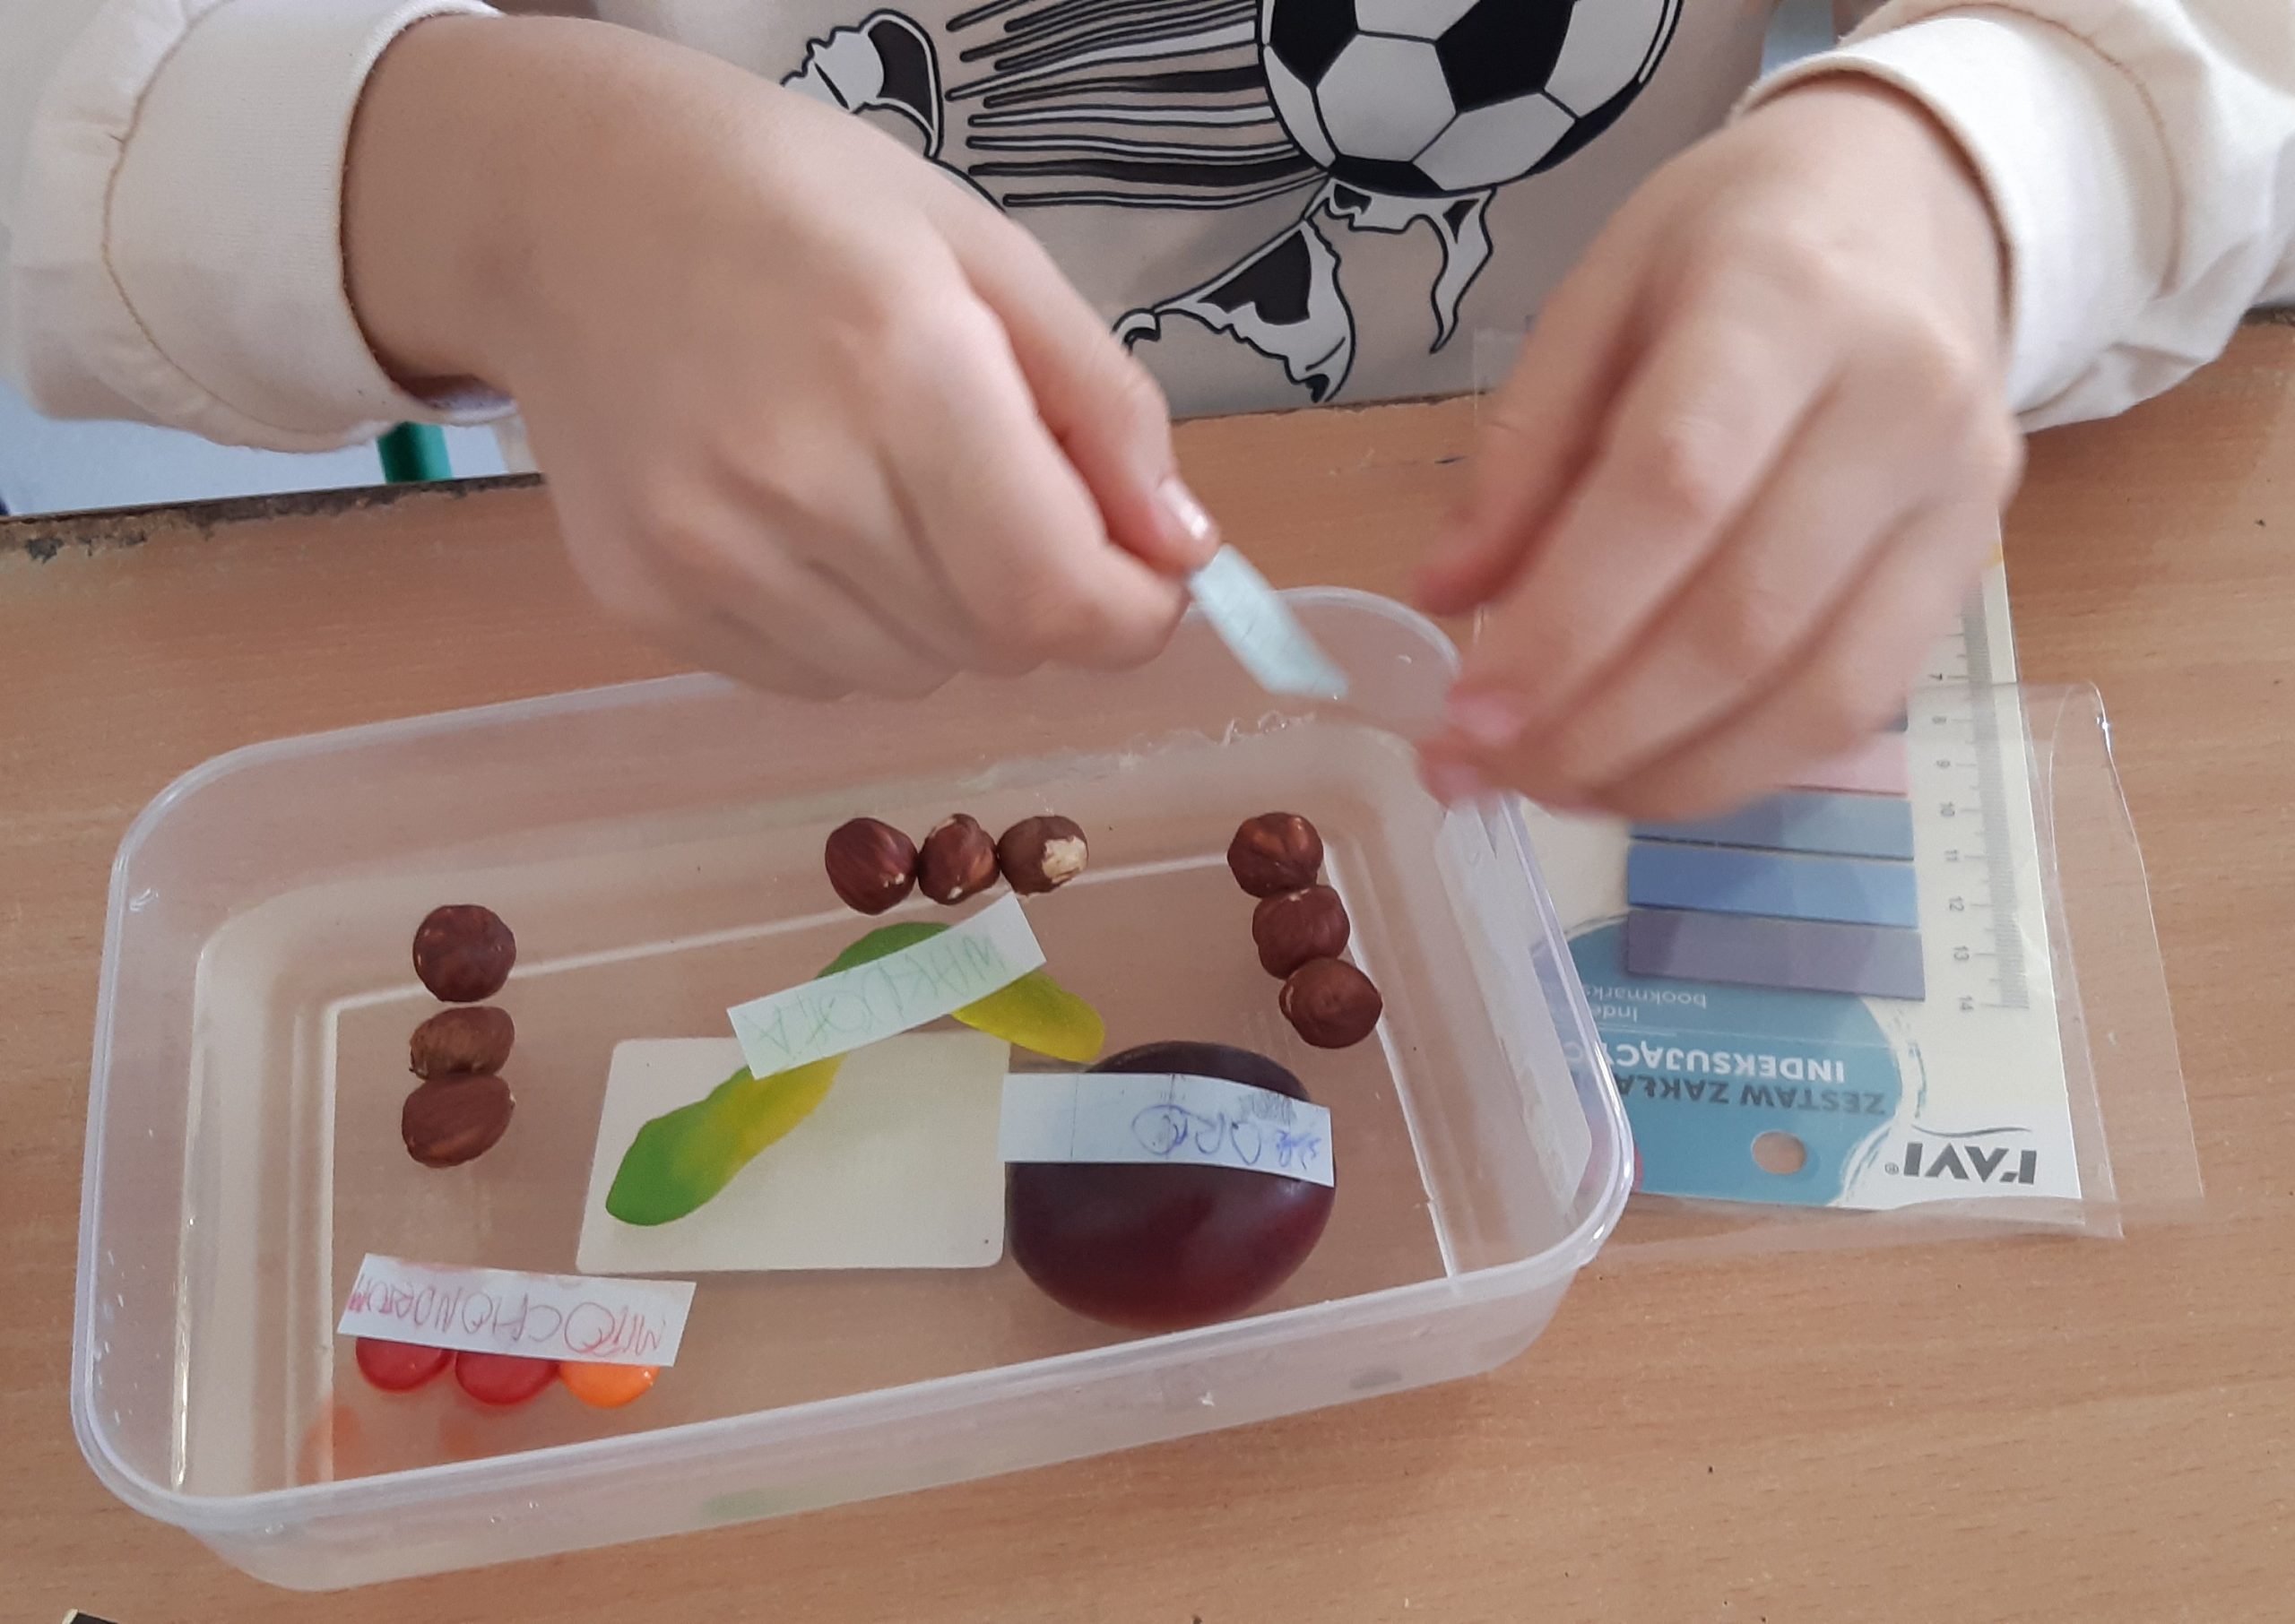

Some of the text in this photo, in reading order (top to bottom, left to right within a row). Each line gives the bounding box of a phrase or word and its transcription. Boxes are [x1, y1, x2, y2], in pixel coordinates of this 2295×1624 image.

[1940, 801, 1955, 817] 10
[1949, 896, 1965, 911] 12
[1953, 946, 1970, 961] 13
[1959, 995, 1974, 1012] 14
[1617, 1071, 1887, 1117] ZESTAW ZAKŁA
